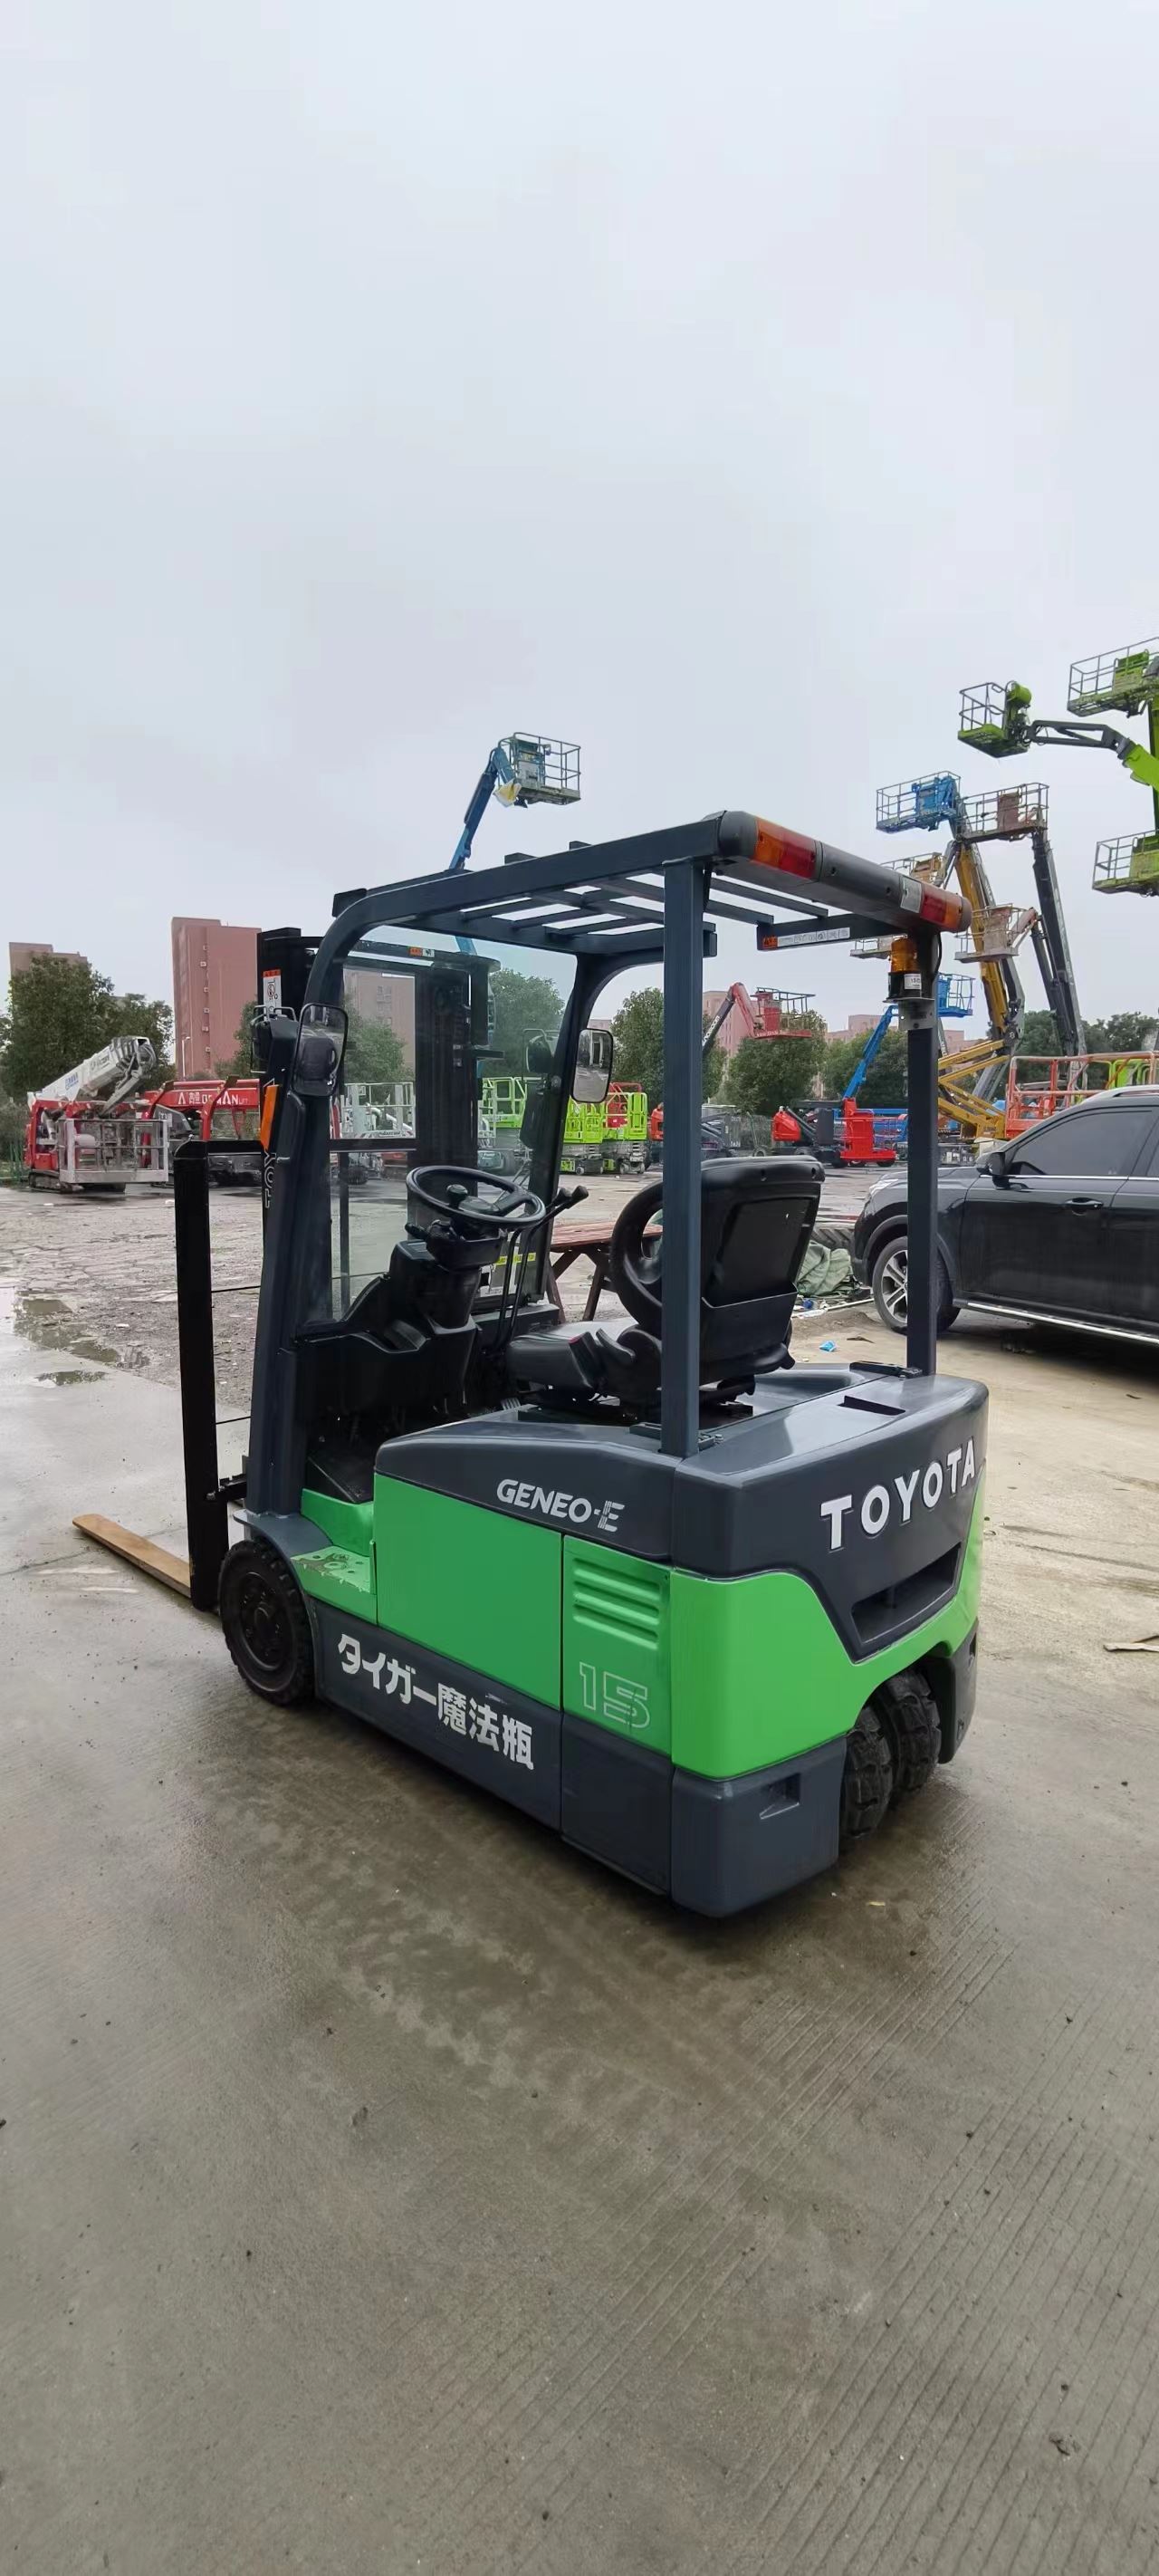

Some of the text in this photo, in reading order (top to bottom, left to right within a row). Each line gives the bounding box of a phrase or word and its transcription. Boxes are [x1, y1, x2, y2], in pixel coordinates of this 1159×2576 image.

[820, 1438, 975, 1550] TOYOTA
[338, 1633, 534, 1771] タイガー魔法瓶
[580, 1660, 650, 1728] 15
